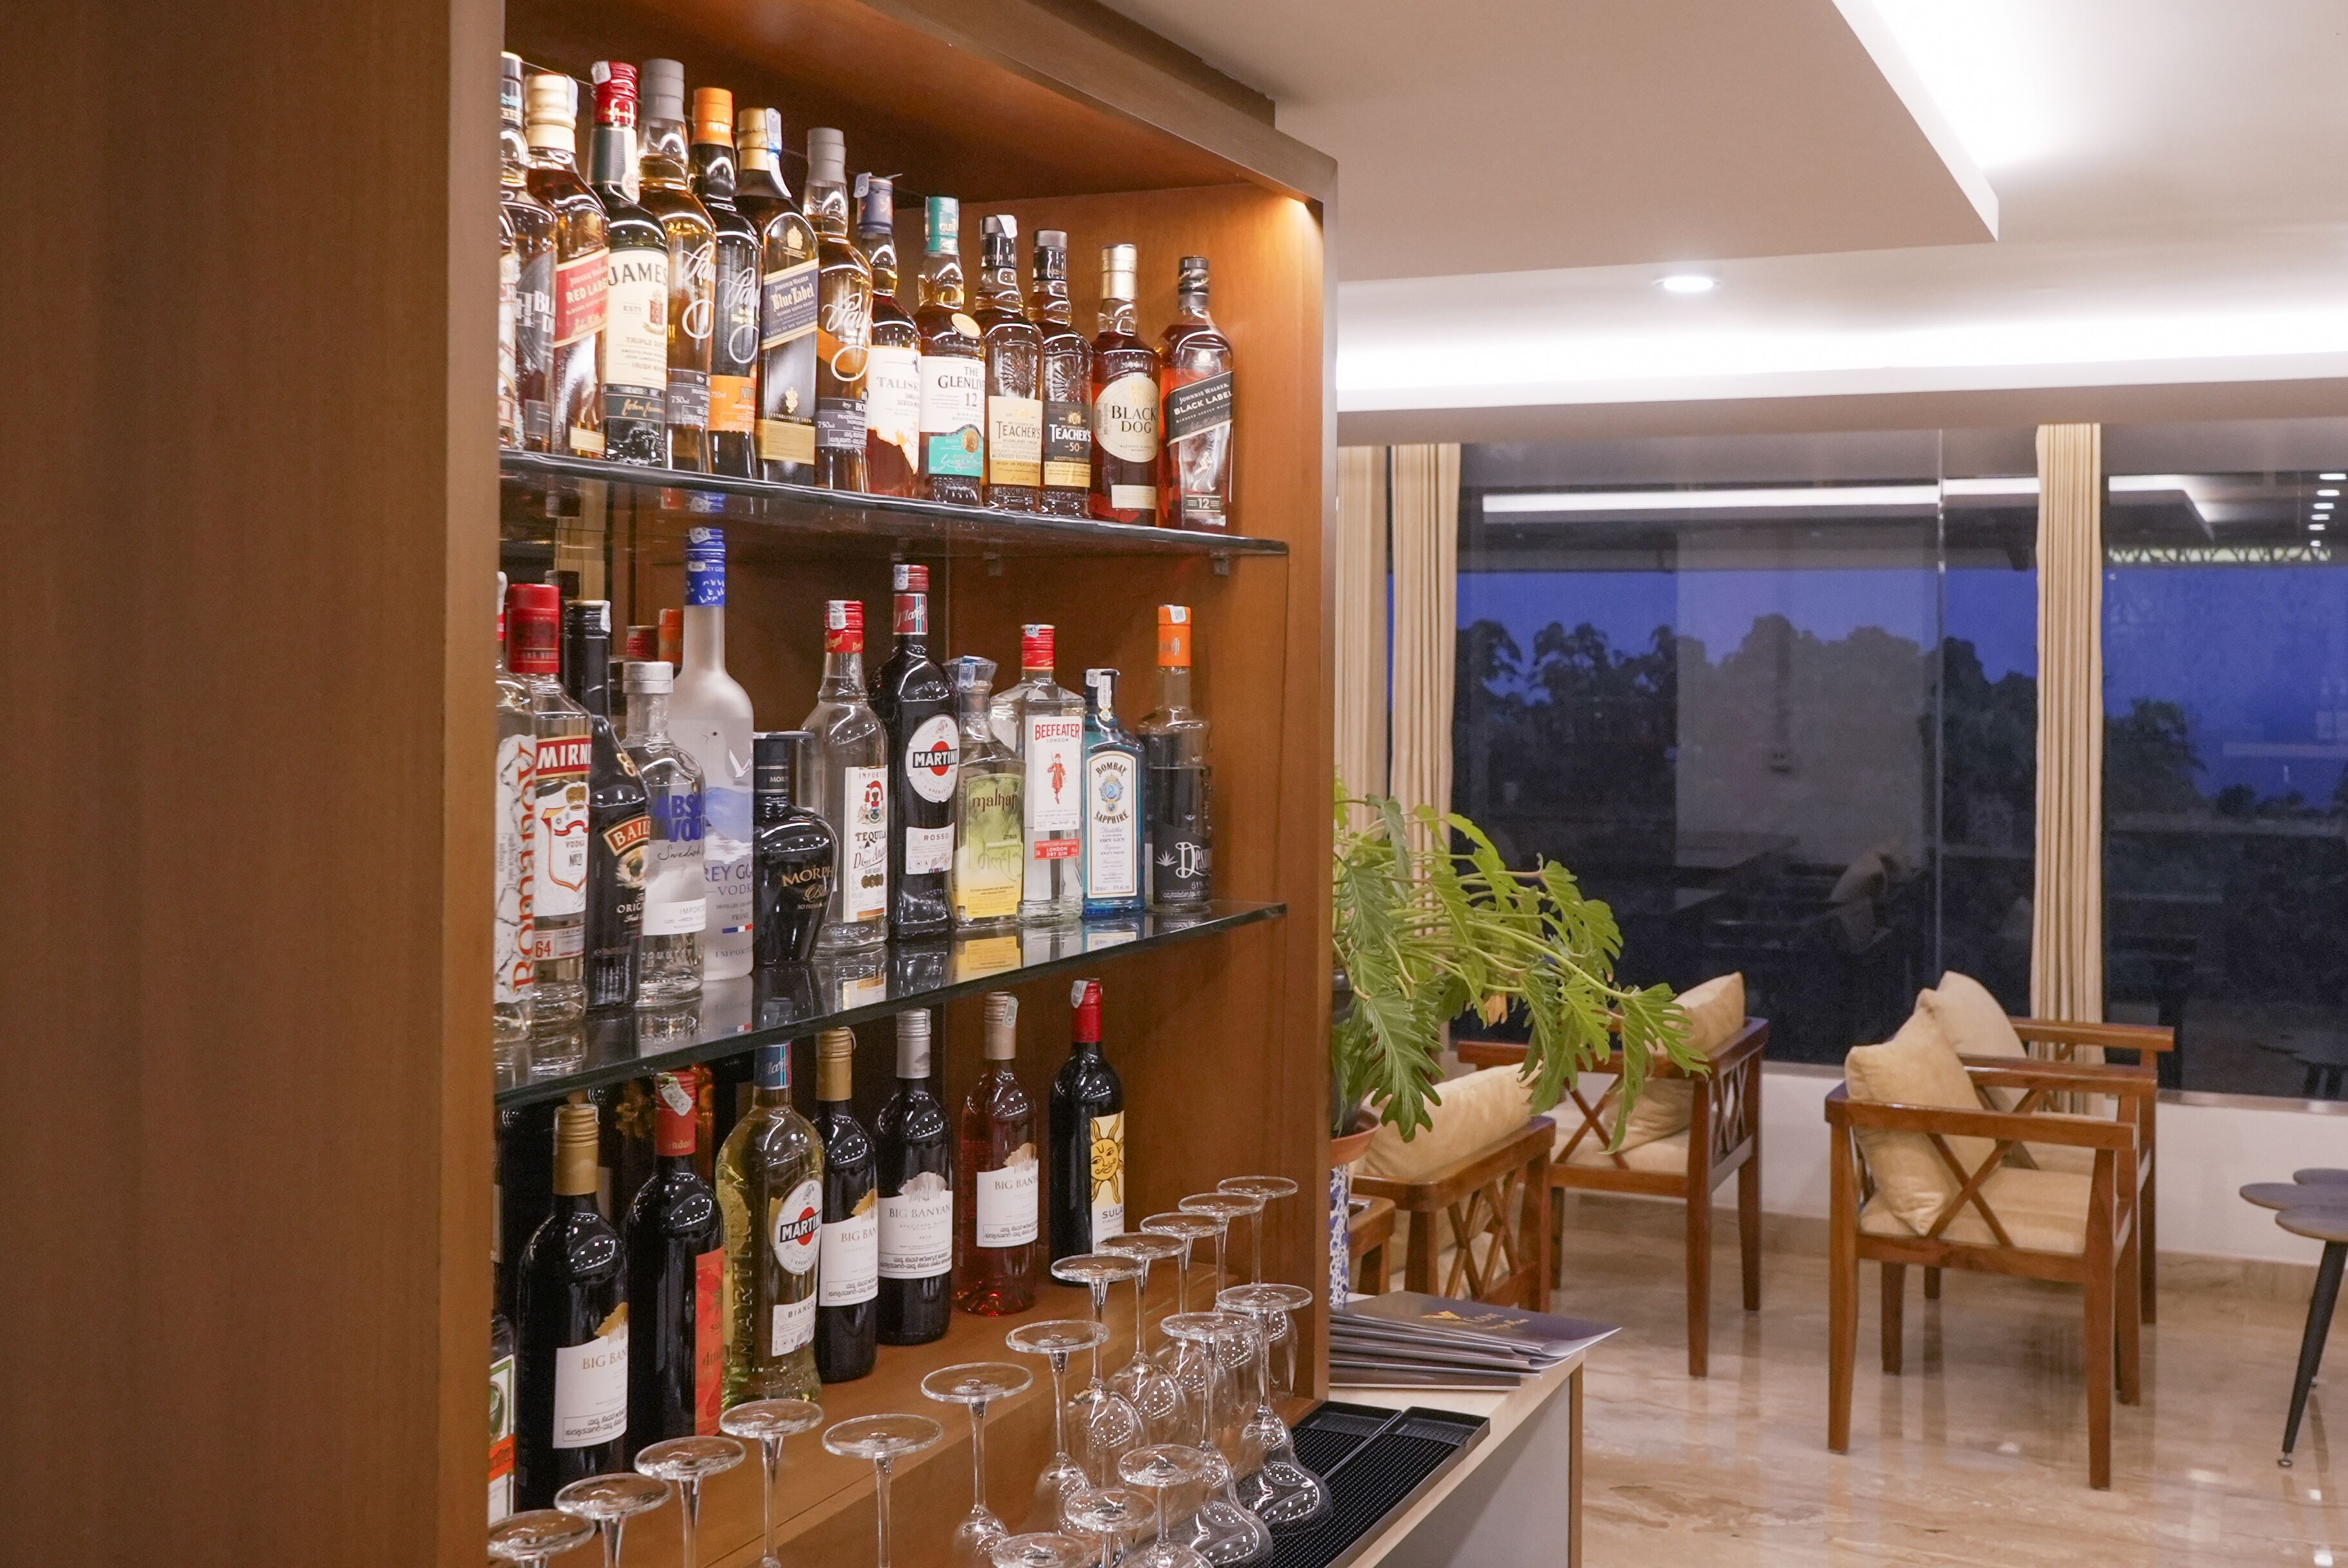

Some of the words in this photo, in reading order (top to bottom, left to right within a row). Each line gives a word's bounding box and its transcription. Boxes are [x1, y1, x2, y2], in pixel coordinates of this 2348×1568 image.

[565, 286, 587, 304] RED
[771, 293, 793, 312] Blue
[790, 283, 814, 305] Label
[964, 366, 979, 377] THE
[965, 393, 977, 407] 12
[1174, 400, 1205, 415] BLACK
[1205, 390, 1232, 405] LABEL
[1179, 390, 1205, 405] JOHNNIE
[1112, 405, 1156, 422] BLACK
[996, 421, 1040, 440] TEACHER'S
[1049, 424, 1092, 443] TEACHER'S
[1121, 420, 1152, 434] DOG
[1197, 498, 1210, 509] 12
[1035, 723, 1080, 741] BEEFEATER
[1095, 762, 1128, 778] BOMBAY
[972, 788, 1018, 812] malhar
[1094, 809, 1131, 824] SAPPHIRE
[924, 832, 949, 841] ROSSO
[536, 940, 551, 958] 64
[995, 1180, 1013, 1191] BIG
[889, 1208, 907, 1218] BIG
[911, 1203, 950, 1218] BANYAN
[841, 1231, 859, 1242] BIG
[583, 1354, 606, 1370] BIG
